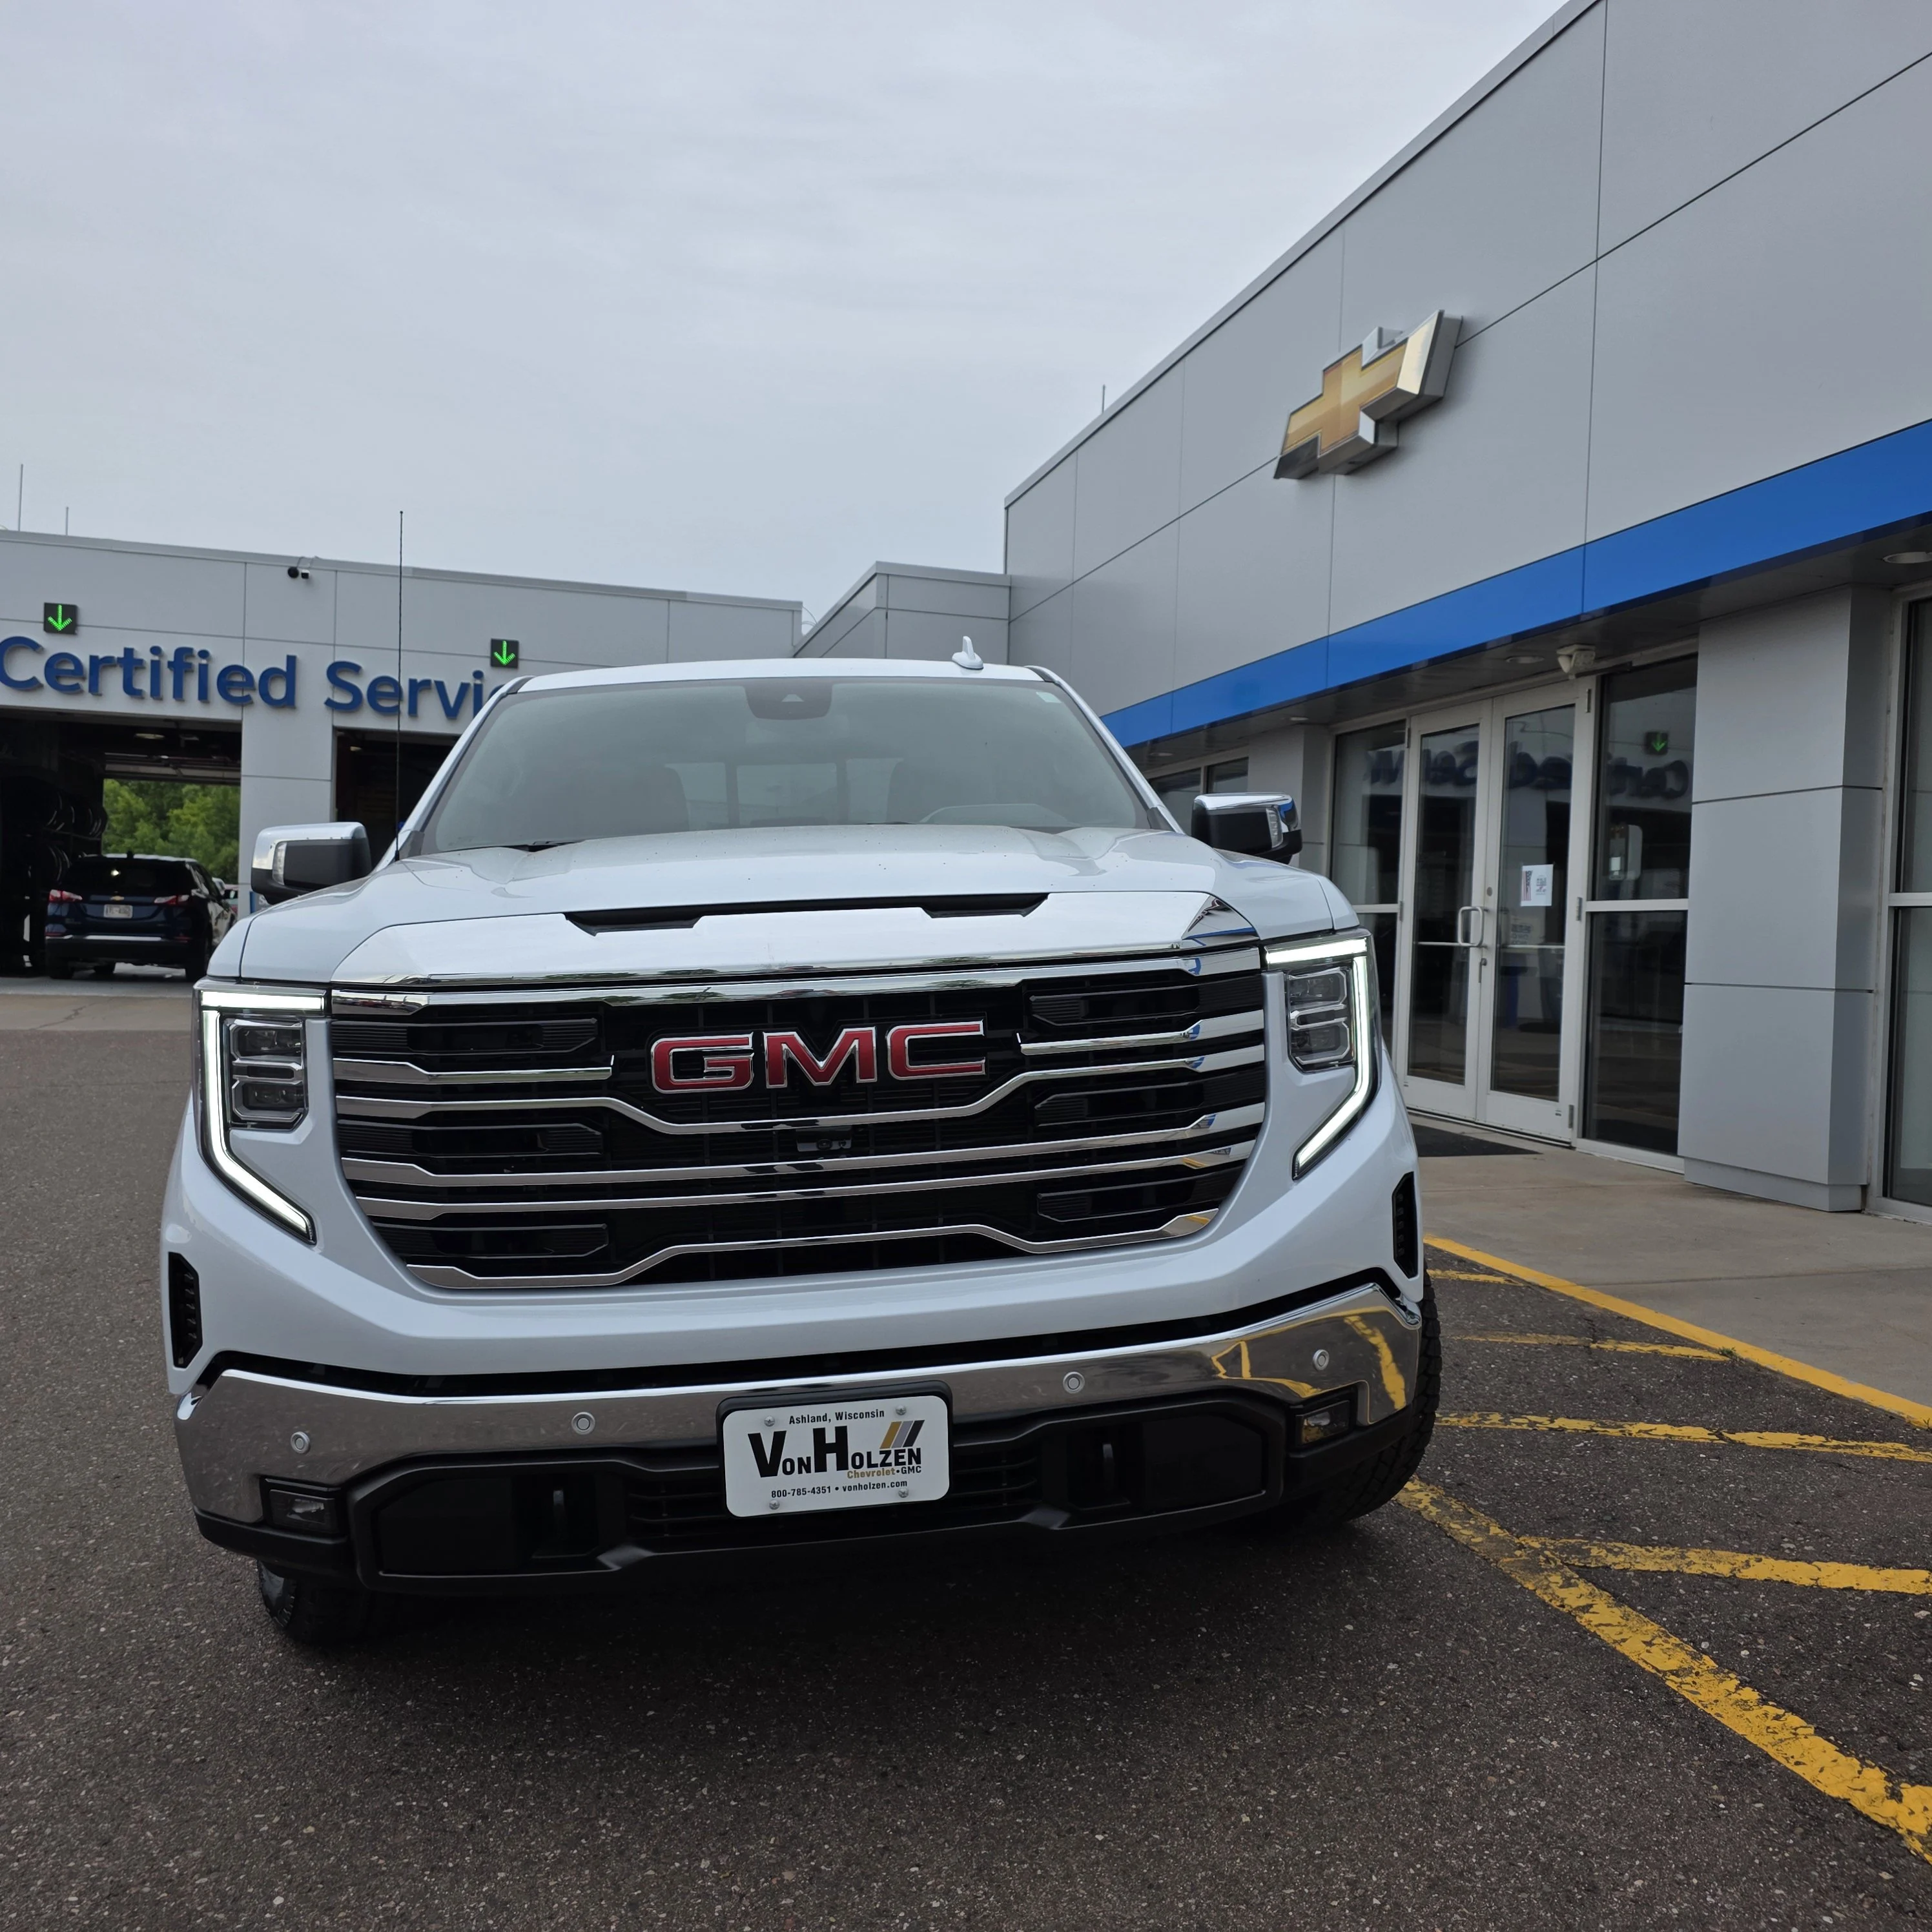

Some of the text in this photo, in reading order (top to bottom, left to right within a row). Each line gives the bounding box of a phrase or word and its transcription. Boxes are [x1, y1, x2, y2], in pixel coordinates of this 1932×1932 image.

[0, 636, 505, 719] Certified Servi
[650, 1019, 986, 1094] GMC
[789, 1409, 885, 1424] Ashland, Wisconsin
[771, 1480, 908, 1498] 800-785-4351 vonholzen.com
